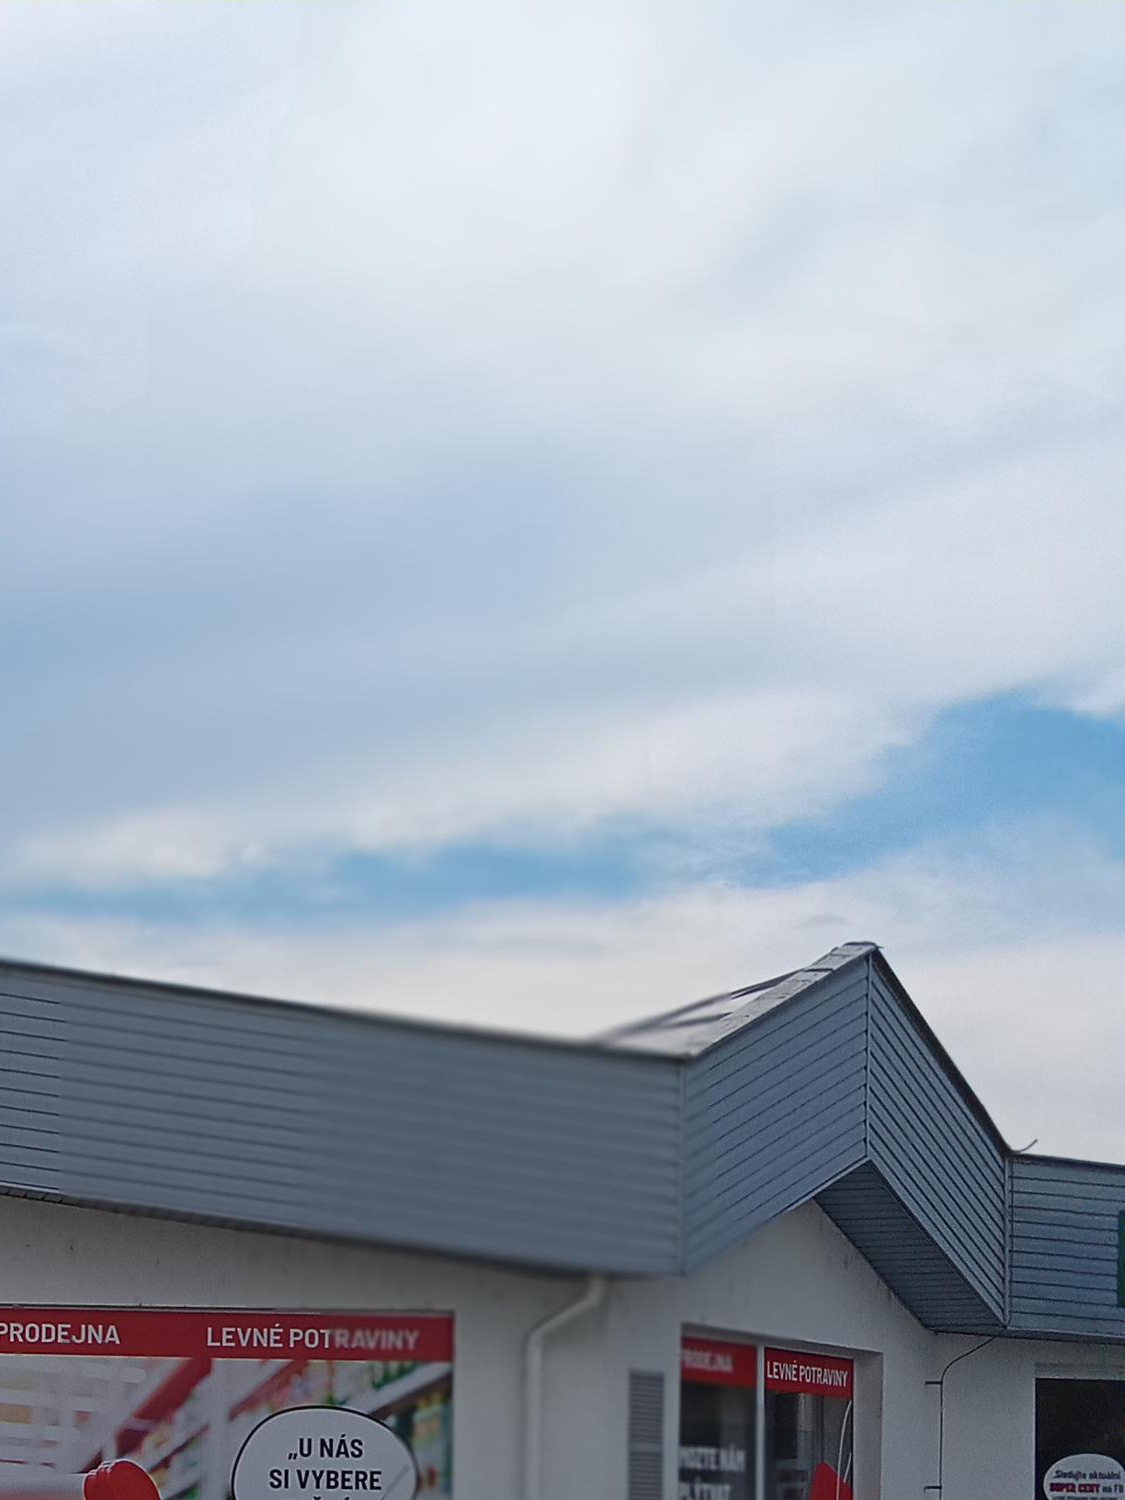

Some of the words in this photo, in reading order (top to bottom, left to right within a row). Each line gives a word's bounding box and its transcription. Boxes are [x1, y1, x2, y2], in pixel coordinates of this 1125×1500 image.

[207, 1323, 283, 1347] LEVNÉ
[289, 1328, 420, 1350] POTRAVINY
[767, 1360, 798, 1381] LEVNÉ
[799, 1366, 848, 1388] POTRAVINY
[288, 1438, 312, 1460] „U
[319, 1434, 363, 1458] NÁS
[269, 1469, 289, 1489] SI
[296, 1469, 382, 1490] VYBERE
